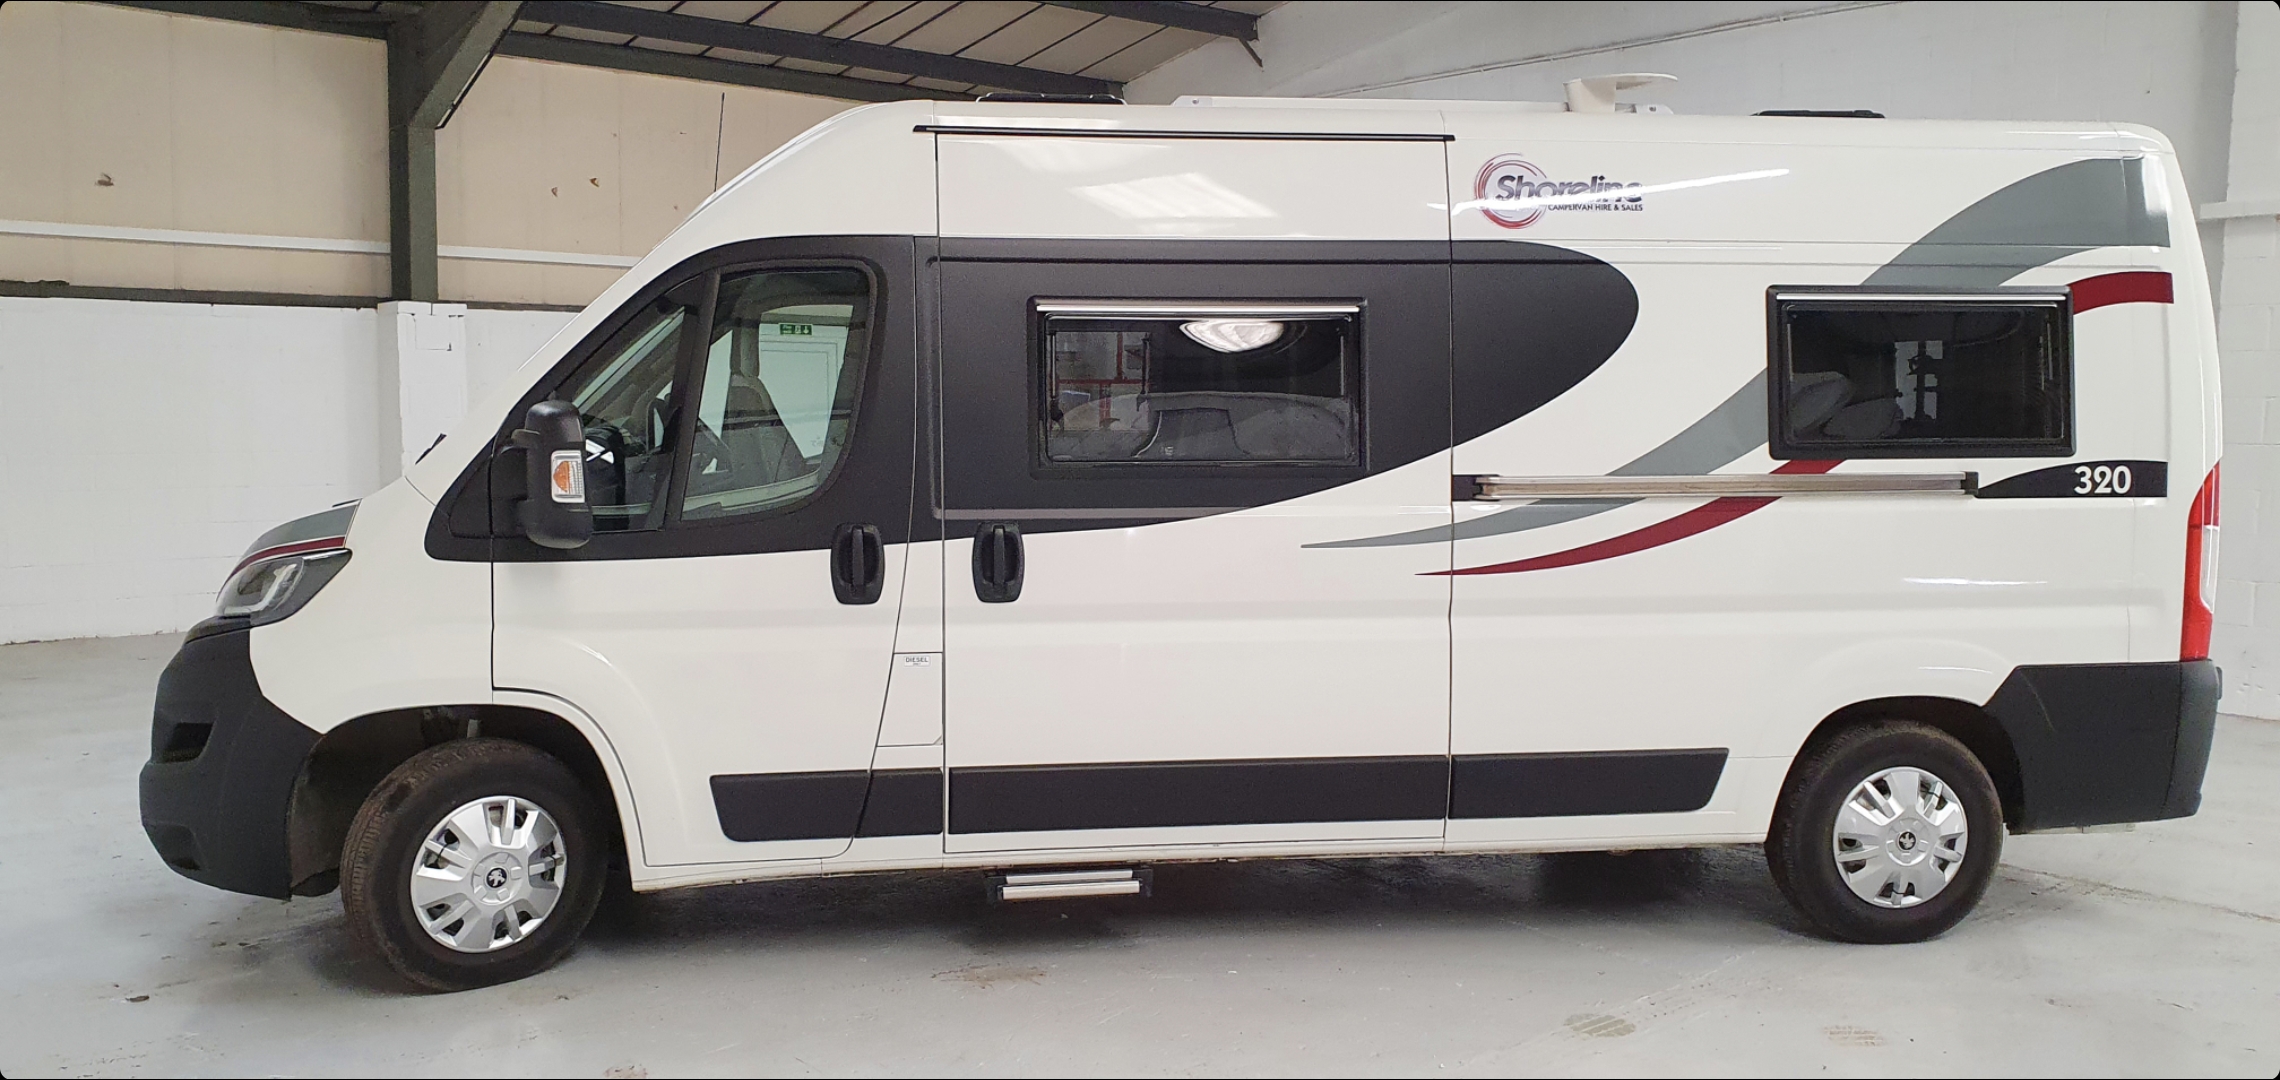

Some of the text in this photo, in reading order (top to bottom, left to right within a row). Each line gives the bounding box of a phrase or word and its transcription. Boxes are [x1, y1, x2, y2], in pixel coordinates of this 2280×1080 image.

[1548, 203, 1644, 212] CAMPERVAN HIRE & SALES
[2073, 465, 2132, 495] 320
